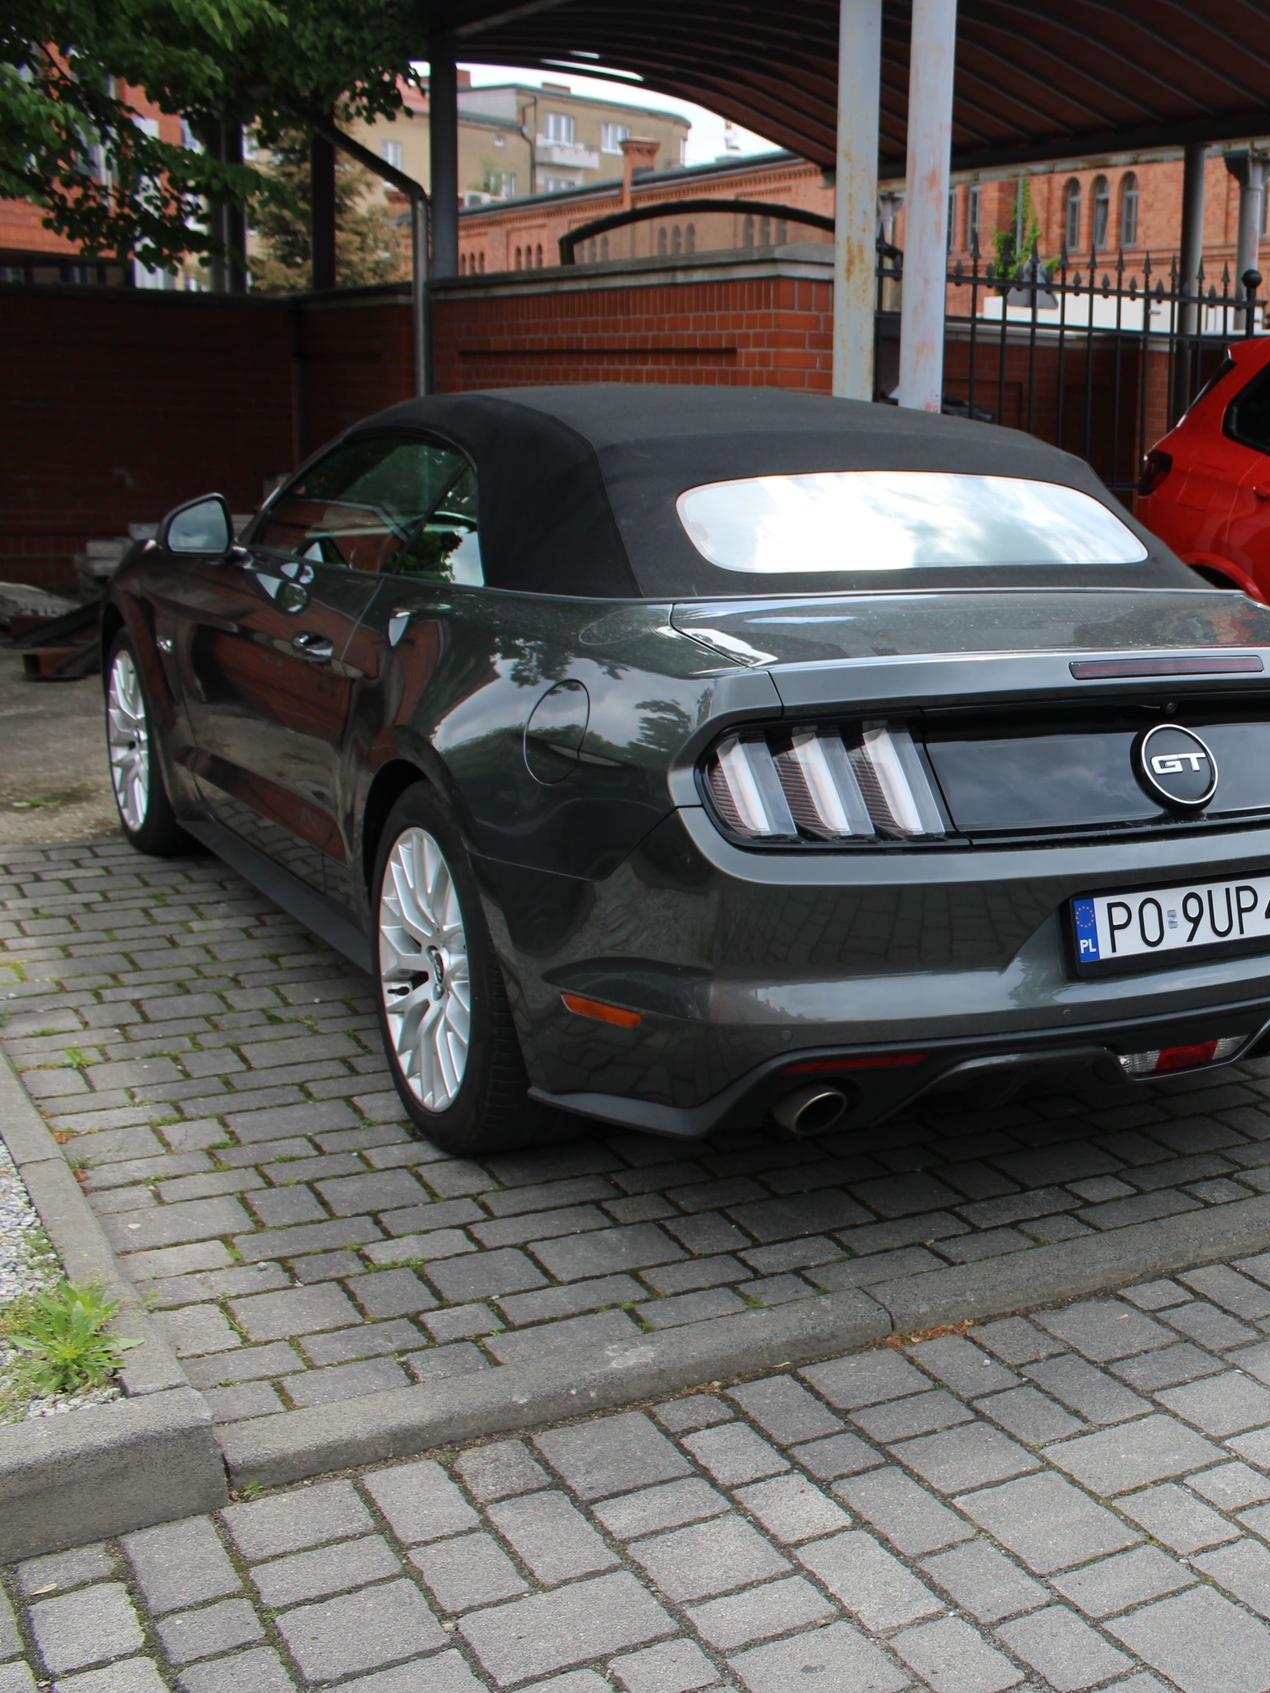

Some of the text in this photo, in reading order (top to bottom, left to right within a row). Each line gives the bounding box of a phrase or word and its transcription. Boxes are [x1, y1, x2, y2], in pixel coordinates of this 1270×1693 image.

[1151, 752, 1206, 774] GT
[1106, 897, 1165, 953] PO
[1080, 938, 1097, 954] PL
